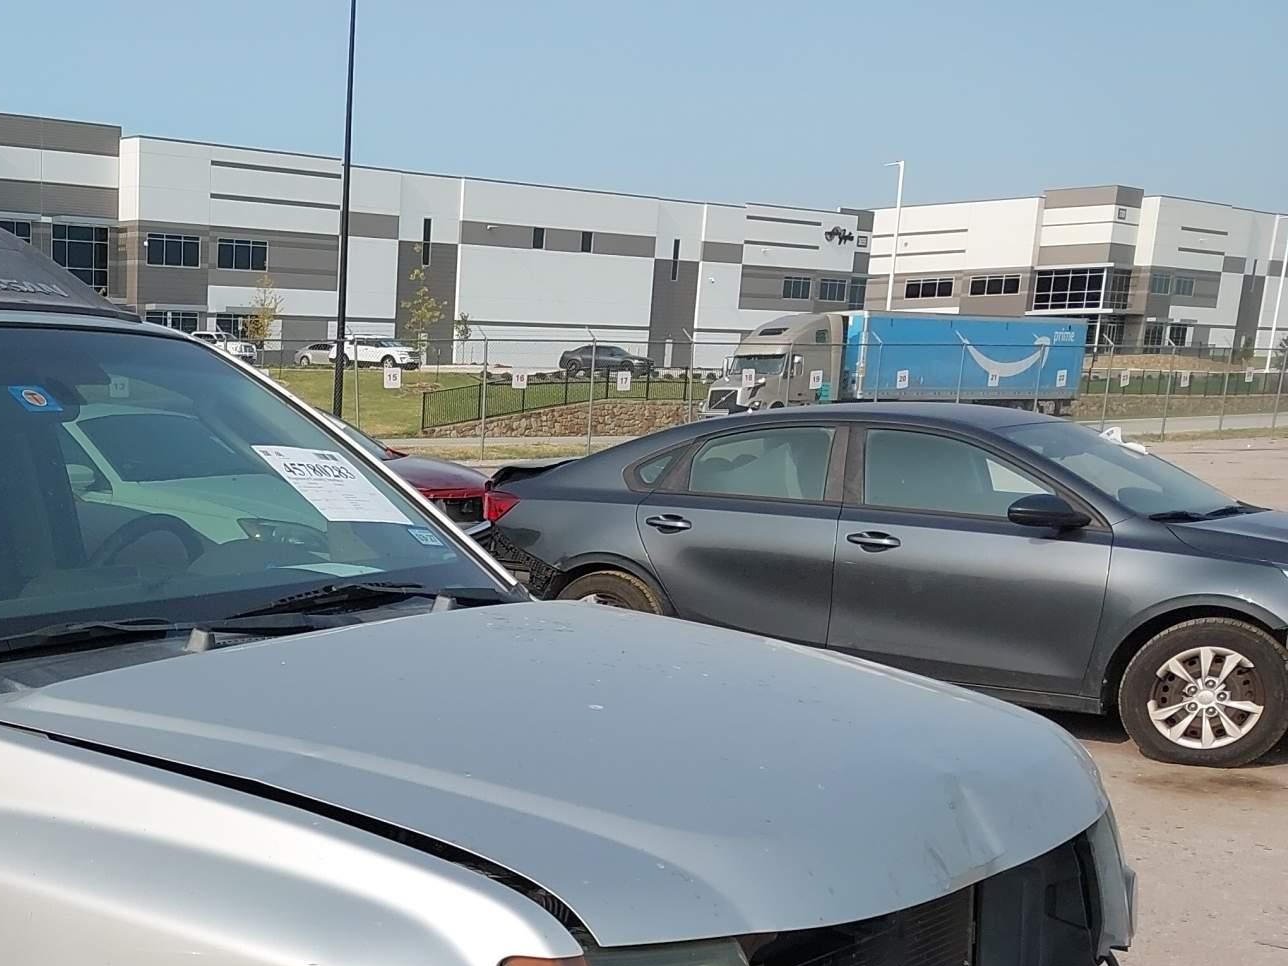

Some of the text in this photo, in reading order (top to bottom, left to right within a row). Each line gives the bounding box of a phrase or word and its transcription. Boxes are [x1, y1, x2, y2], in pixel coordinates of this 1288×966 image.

[1053, 328, 1075, 345] prime
[387, 374, 398, 382] 15
[620, 377, 628, 385] 17
[284, 463, 355, 480] 45780283
